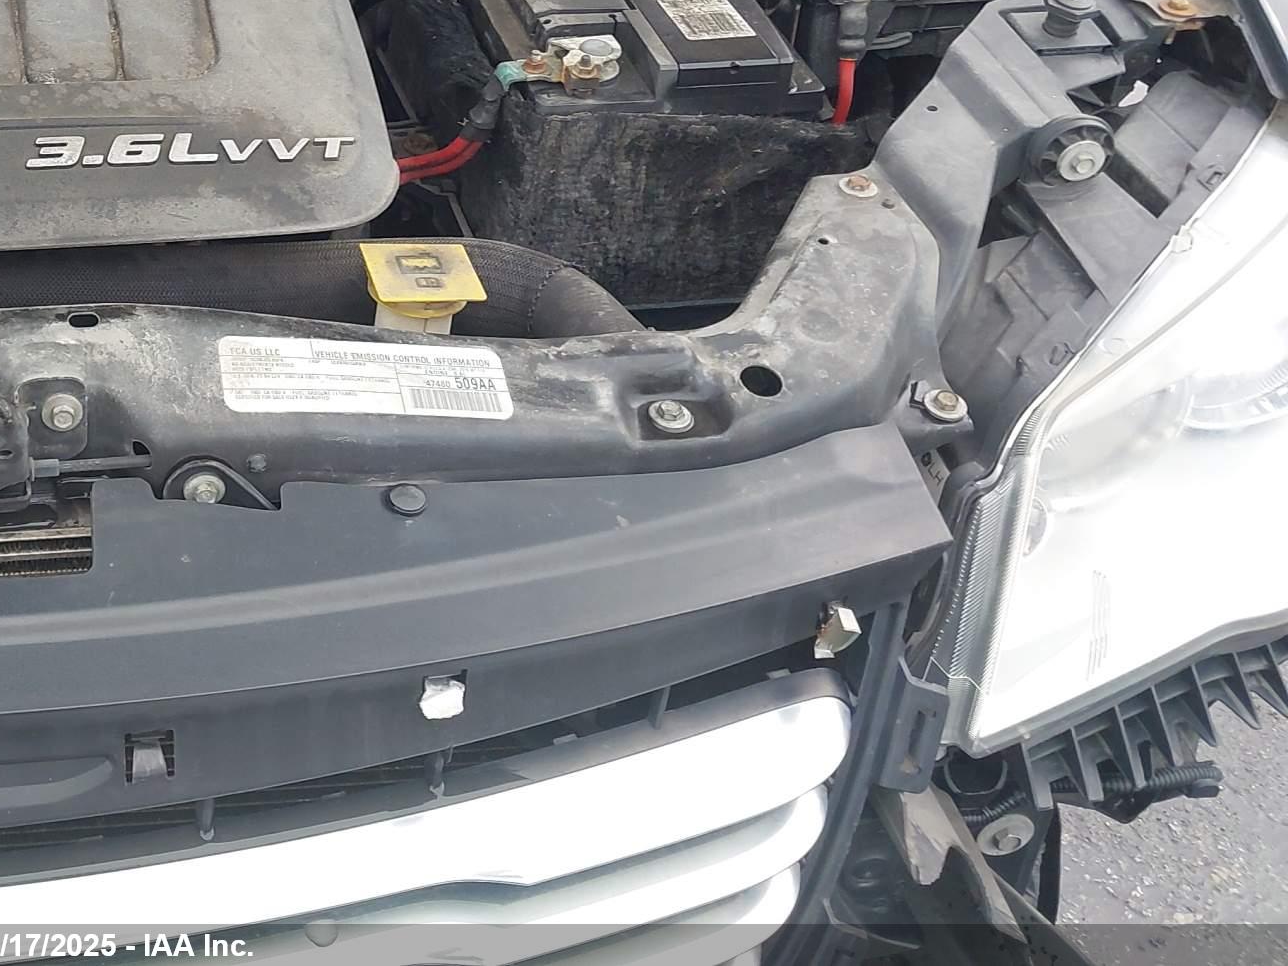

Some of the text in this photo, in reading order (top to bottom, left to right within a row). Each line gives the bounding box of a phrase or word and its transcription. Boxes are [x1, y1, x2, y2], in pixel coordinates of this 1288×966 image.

[230, 347, 280, 356] FCA US LLC
[314, 350, 490, 367] VEHICLE EMISSION CONTROL INFORMATION
[454, 377, 496, 390] 509AA
[928, 462, 944, 487] LH
